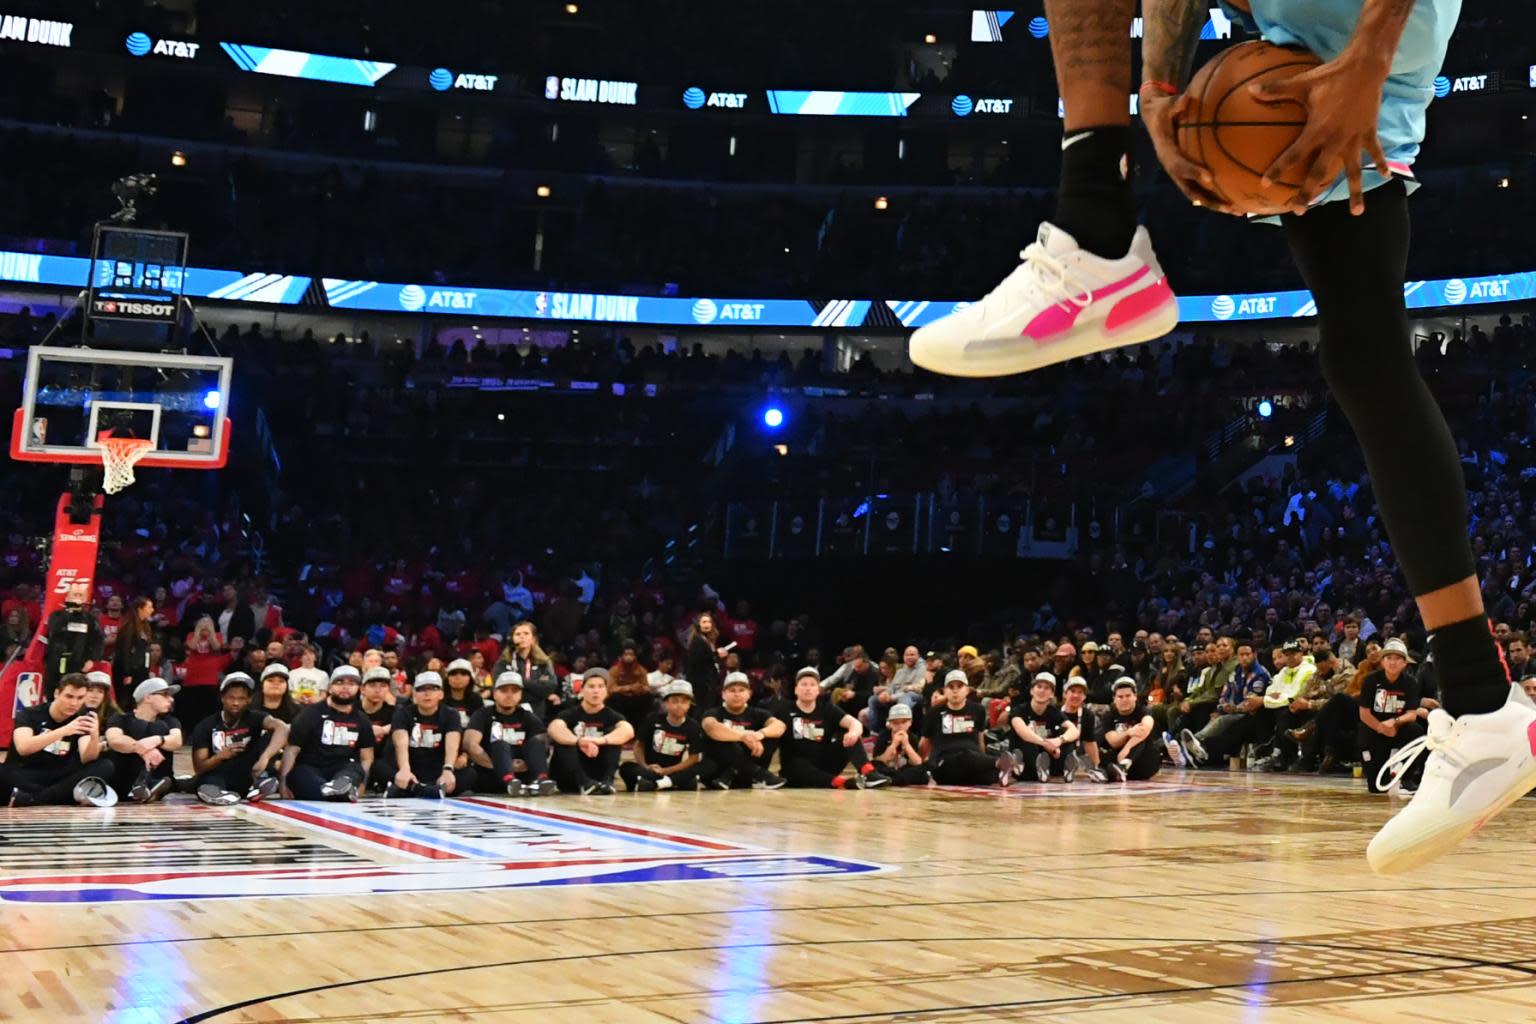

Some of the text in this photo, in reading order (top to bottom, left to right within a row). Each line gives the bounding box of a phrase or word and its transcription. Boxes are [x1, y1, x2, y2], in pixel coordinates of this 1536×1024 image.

[27, 18, 73, 47] DUNK
[153, 39, 200, 58] AT&T
[455, 73, 497, 90] AT&T
[1453, 75, 1487, 92] AT&T
[561, 78, 637, 104] SLAM DUNK
[707, 93, 747, 108] AT&T
[975, 100, 1013, 113] AT&T
[0, 251, 42, 282] UNK
[1470, 280, 1509, 297] AT&T
[429, 291, 476, 308] AT&T
[552, 293, 639, 322] SLAM DUNK
[1239, 296, 1277, 314] AT&T
[118, 302, 175, 316] TISSOT
[720, 303, 764, 319] AT&T
